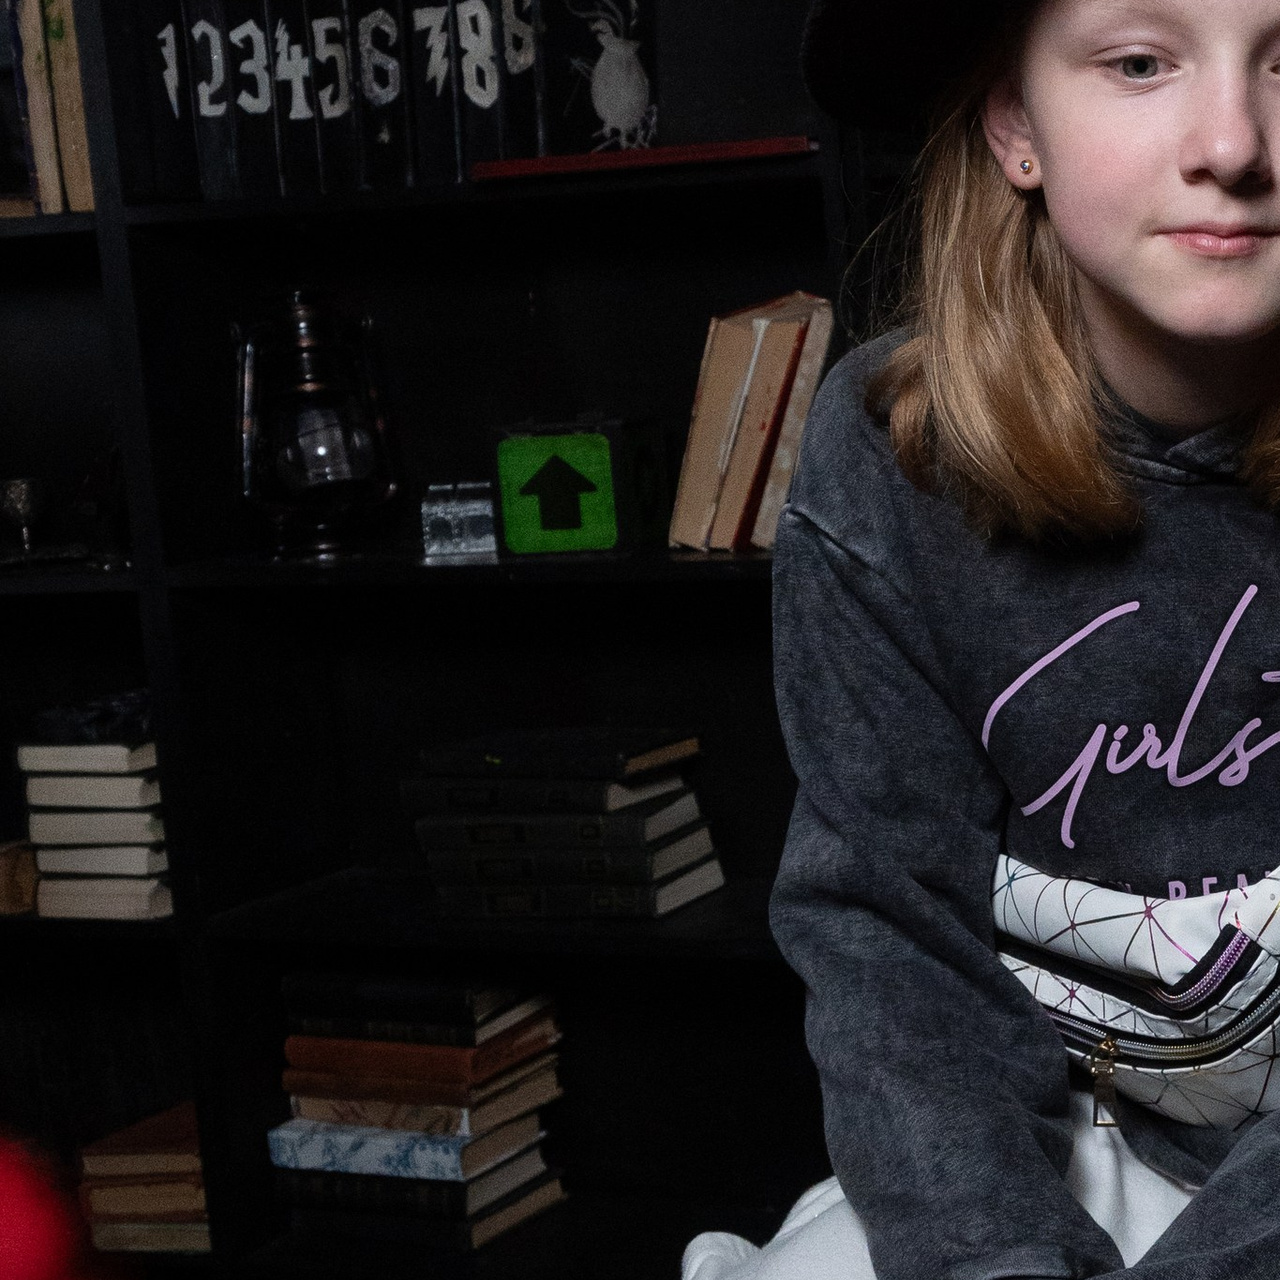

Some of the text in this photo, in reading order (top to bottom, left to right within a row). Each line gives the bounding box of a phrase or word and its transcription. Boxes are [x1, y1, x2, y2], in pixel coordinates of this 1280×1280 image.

[157, 22, 180, 119] 1
[191, 18, 228, 118] 2
[229, 19, 271, 114] 3
[275, 18, 313, 120] 4
[311, 16, 350, 119] 5
[358, 7, 400, 107] 6
[413, 5, 449, 97] 7
